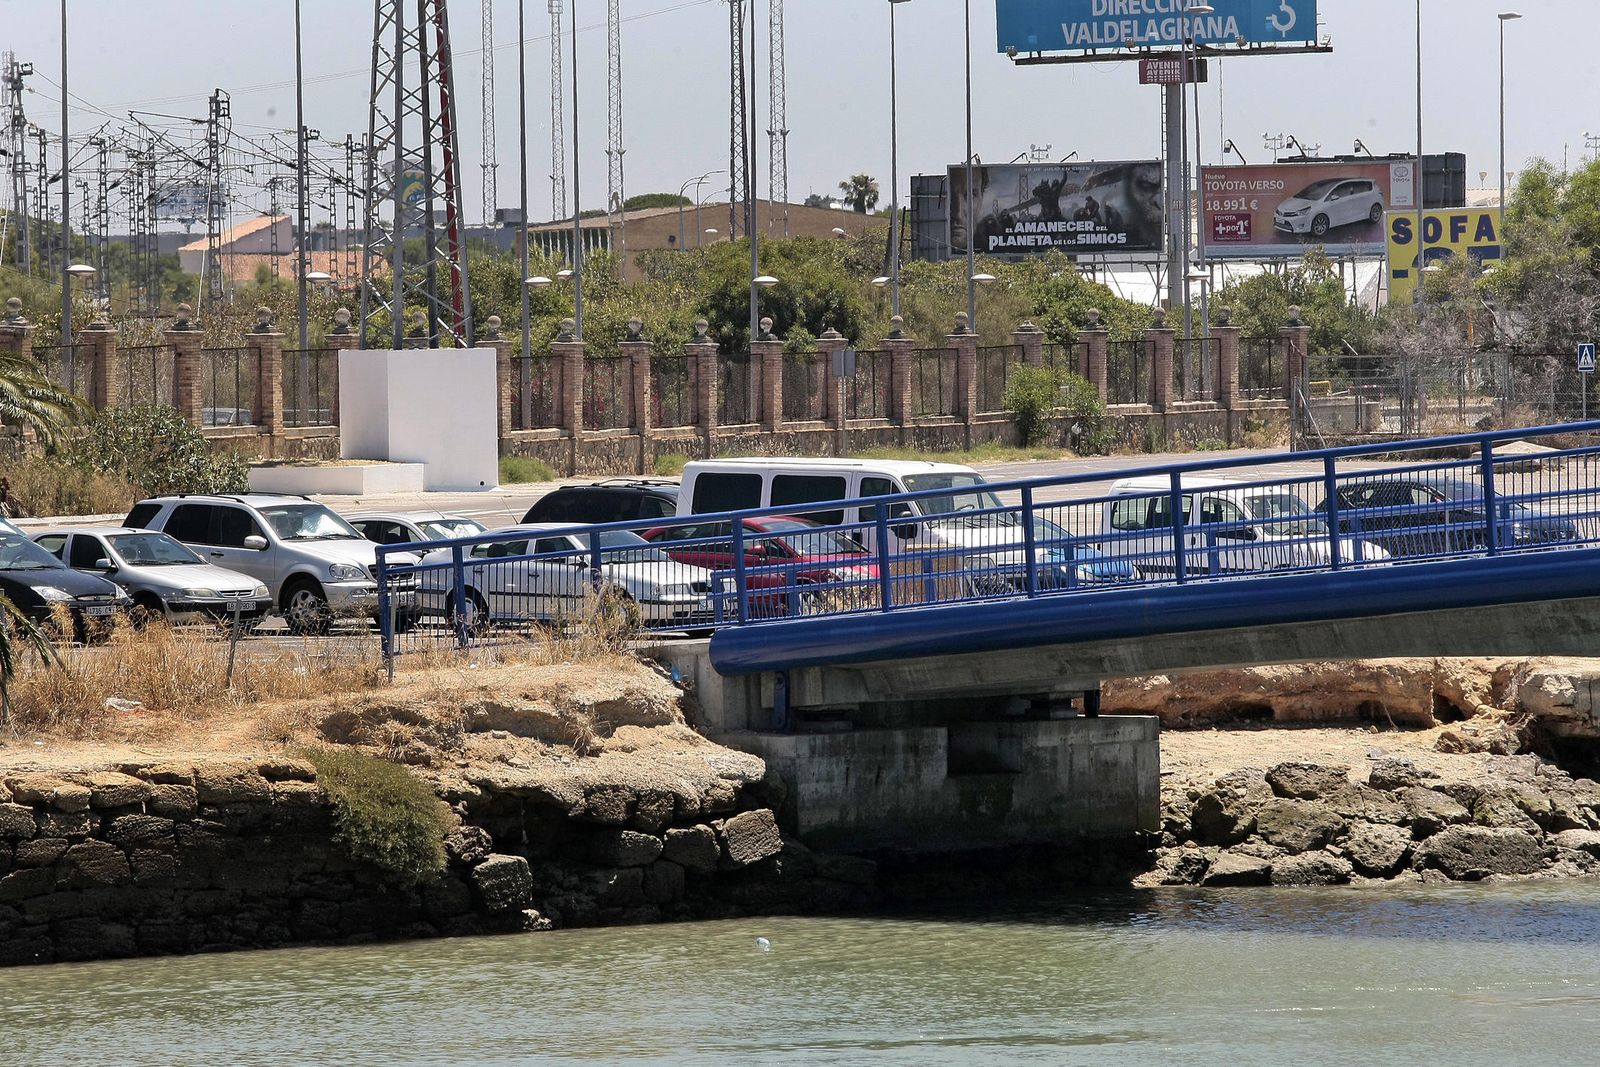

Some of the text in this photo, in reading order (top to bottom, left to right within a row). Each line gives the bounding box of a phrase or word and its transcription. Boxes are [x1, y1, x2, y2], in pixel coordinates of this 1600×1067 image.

[1092, 0, 1208, 16] DIRECCI
[1061, 16, 1240, 45] VALDELAGRANA
[1147, 61, 1180, 69] AVENIR
[1205, 180, 1284, 191] TOYOTA VERSO
[1206, 198, 1248, 211] 18.991
[1014, 221, 1094, 233] AMANECER
[989, 235, 1053, 250] PLANETA
[1077, 233, 1127, 244] SIMIOS
